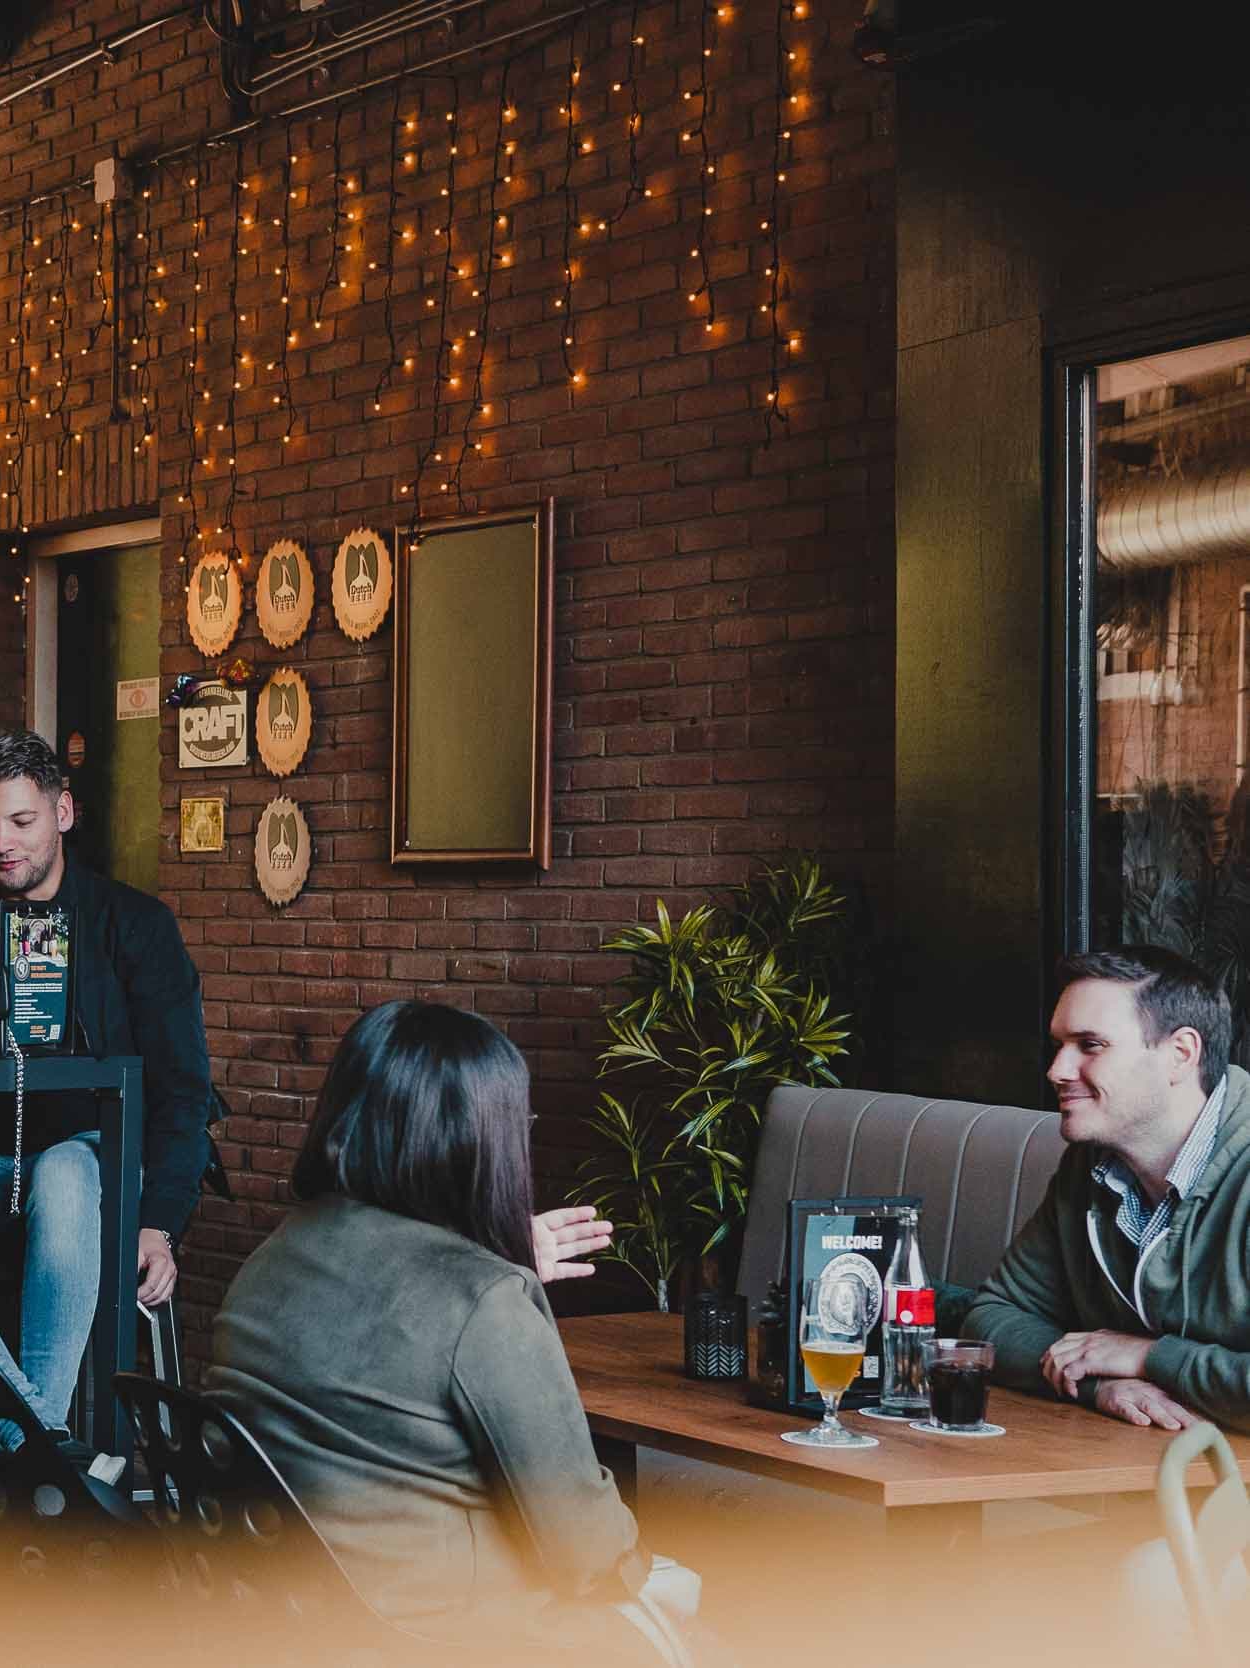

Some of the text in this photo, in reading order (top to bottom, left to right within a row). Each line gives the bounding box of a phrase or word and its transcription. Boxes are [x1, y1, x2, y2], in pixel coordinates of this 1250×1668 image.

[350, 582, 373, 596] Dutch
[181, 705, 245, 742] CRAFT
[821, 1235, 883, 1250] WELCOME!
